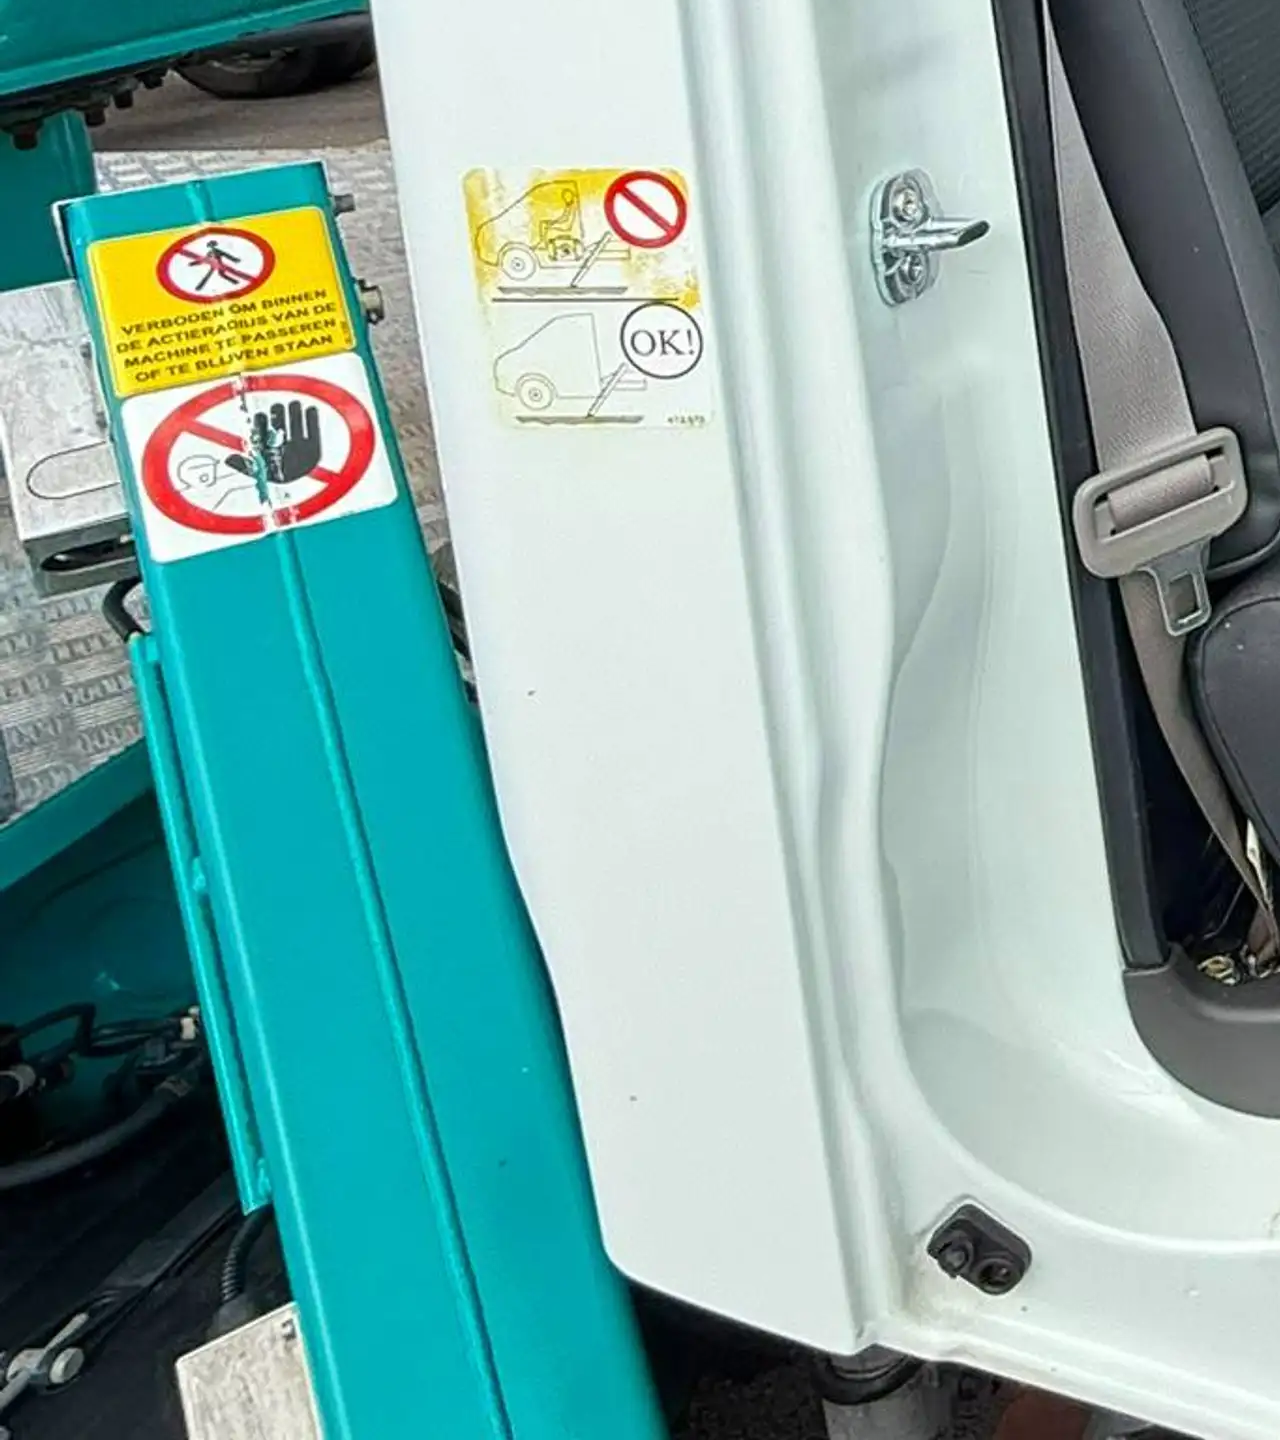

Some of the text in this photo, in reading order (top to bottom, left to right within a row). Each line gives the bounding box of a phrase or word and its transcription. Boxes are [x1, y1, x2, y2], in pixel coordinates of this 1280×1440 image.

[116, 302, 337, 354] DE ACTIERADIUS VAN DE
[120, 288, 328, 336] VERBODEN OM BINNEN
[124, 343, 211, 369] MACHINE
[214, 336, 237, 351] TE
[241, 318, 337, 344] PASSEREN
[135, 334, 333, 382] OF TE BLIJVEN STAAN
[630, 328, 695, 358] OK!
